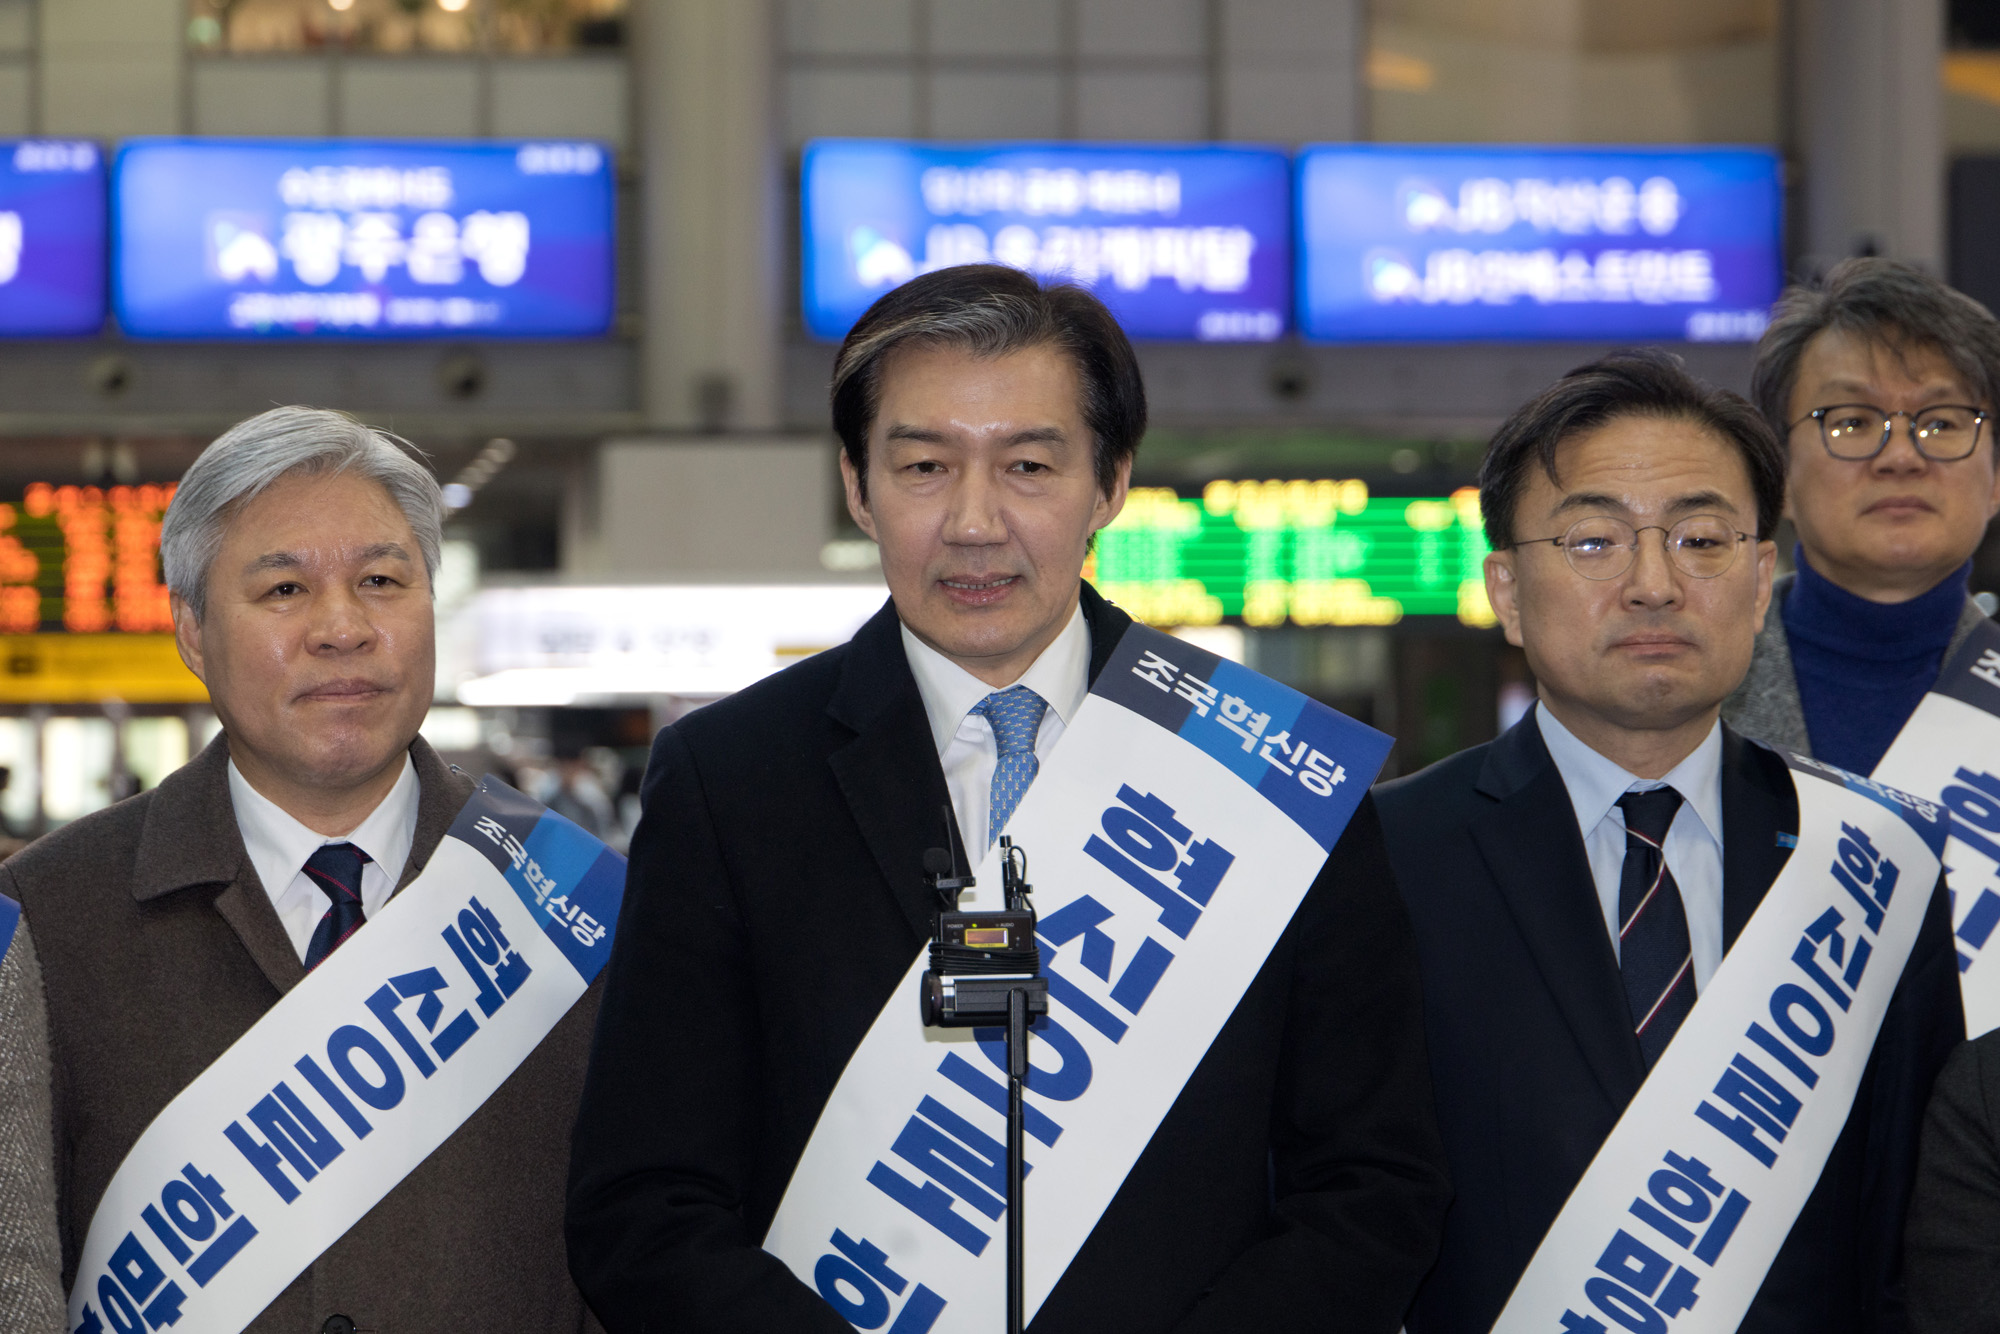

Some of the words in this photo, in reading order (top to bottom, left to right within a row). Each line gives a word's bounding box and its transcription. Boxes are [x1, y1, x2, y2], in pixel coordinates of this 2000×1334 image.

[1132, 650, 1346, 797] 조국혁신당
[473, 816, 605, 948] 조국혁신당
[1694, 821, 1900, 1169] 혁신으로
[223, 896, 532, 1205] 혁신으로
